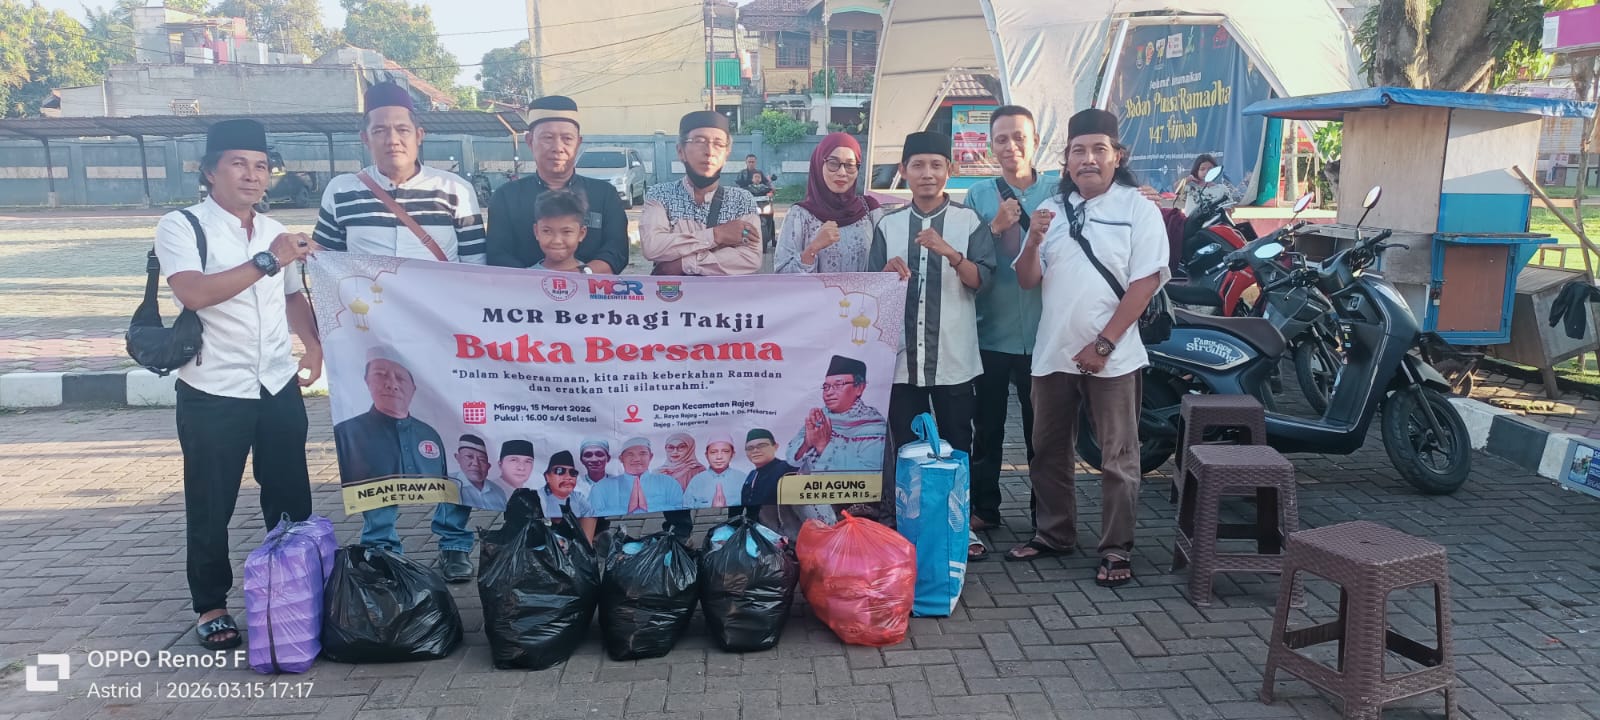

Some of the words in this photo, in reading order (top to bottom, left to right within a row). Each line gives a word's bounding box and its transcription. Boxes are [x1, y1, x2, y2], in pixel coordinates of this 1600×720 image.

[588, 278, 644, 296] MCR
[482, 308, 545, 324] MCR
[555, 309, 670, 331] Berbagi
[680, 311, 765, 333] Takjil
[453, 333, 575, 364] Buka
[584, 336, 785, 363] Bersama
[503, 370, 590, 383] kebersamaan,
[594, 373, 619, 382] kita
[623, 371, 648, 381] raih
[652, 370, 724, 380] keberkahan
[728, 369, 782, 379] Ramadan
[529, 384, 551, 393] dan
[555, 384, 604, 394] eratkan
[608, 383, 629, 394] tali
[493, 403, 529, 413] Minggu,
[541, 404, 568, 412] Maret
[570, 405, 592, 413] 2026
[653, 403, 681, 413] Depan
[682, 401, 730, 411] Kecamatan
[731, 400, 755, 409] Rajeg
[493, 413, 519, 422] Pukul
[525, 413, 548, 422] 16.00
[549, 413, 565, 422] s/d
[566, 415, 597, 423] Selesai
[358, 484, 394, 499] NEAN
[397, 482, 446, 492] IRAWAN
[804, 481, 822, 490] ABI
[825, 481, 866, 490] AGUNG
[382, 494, 424, 503] KETUA
[800, 491, 870, 499] SEKRETARIS
